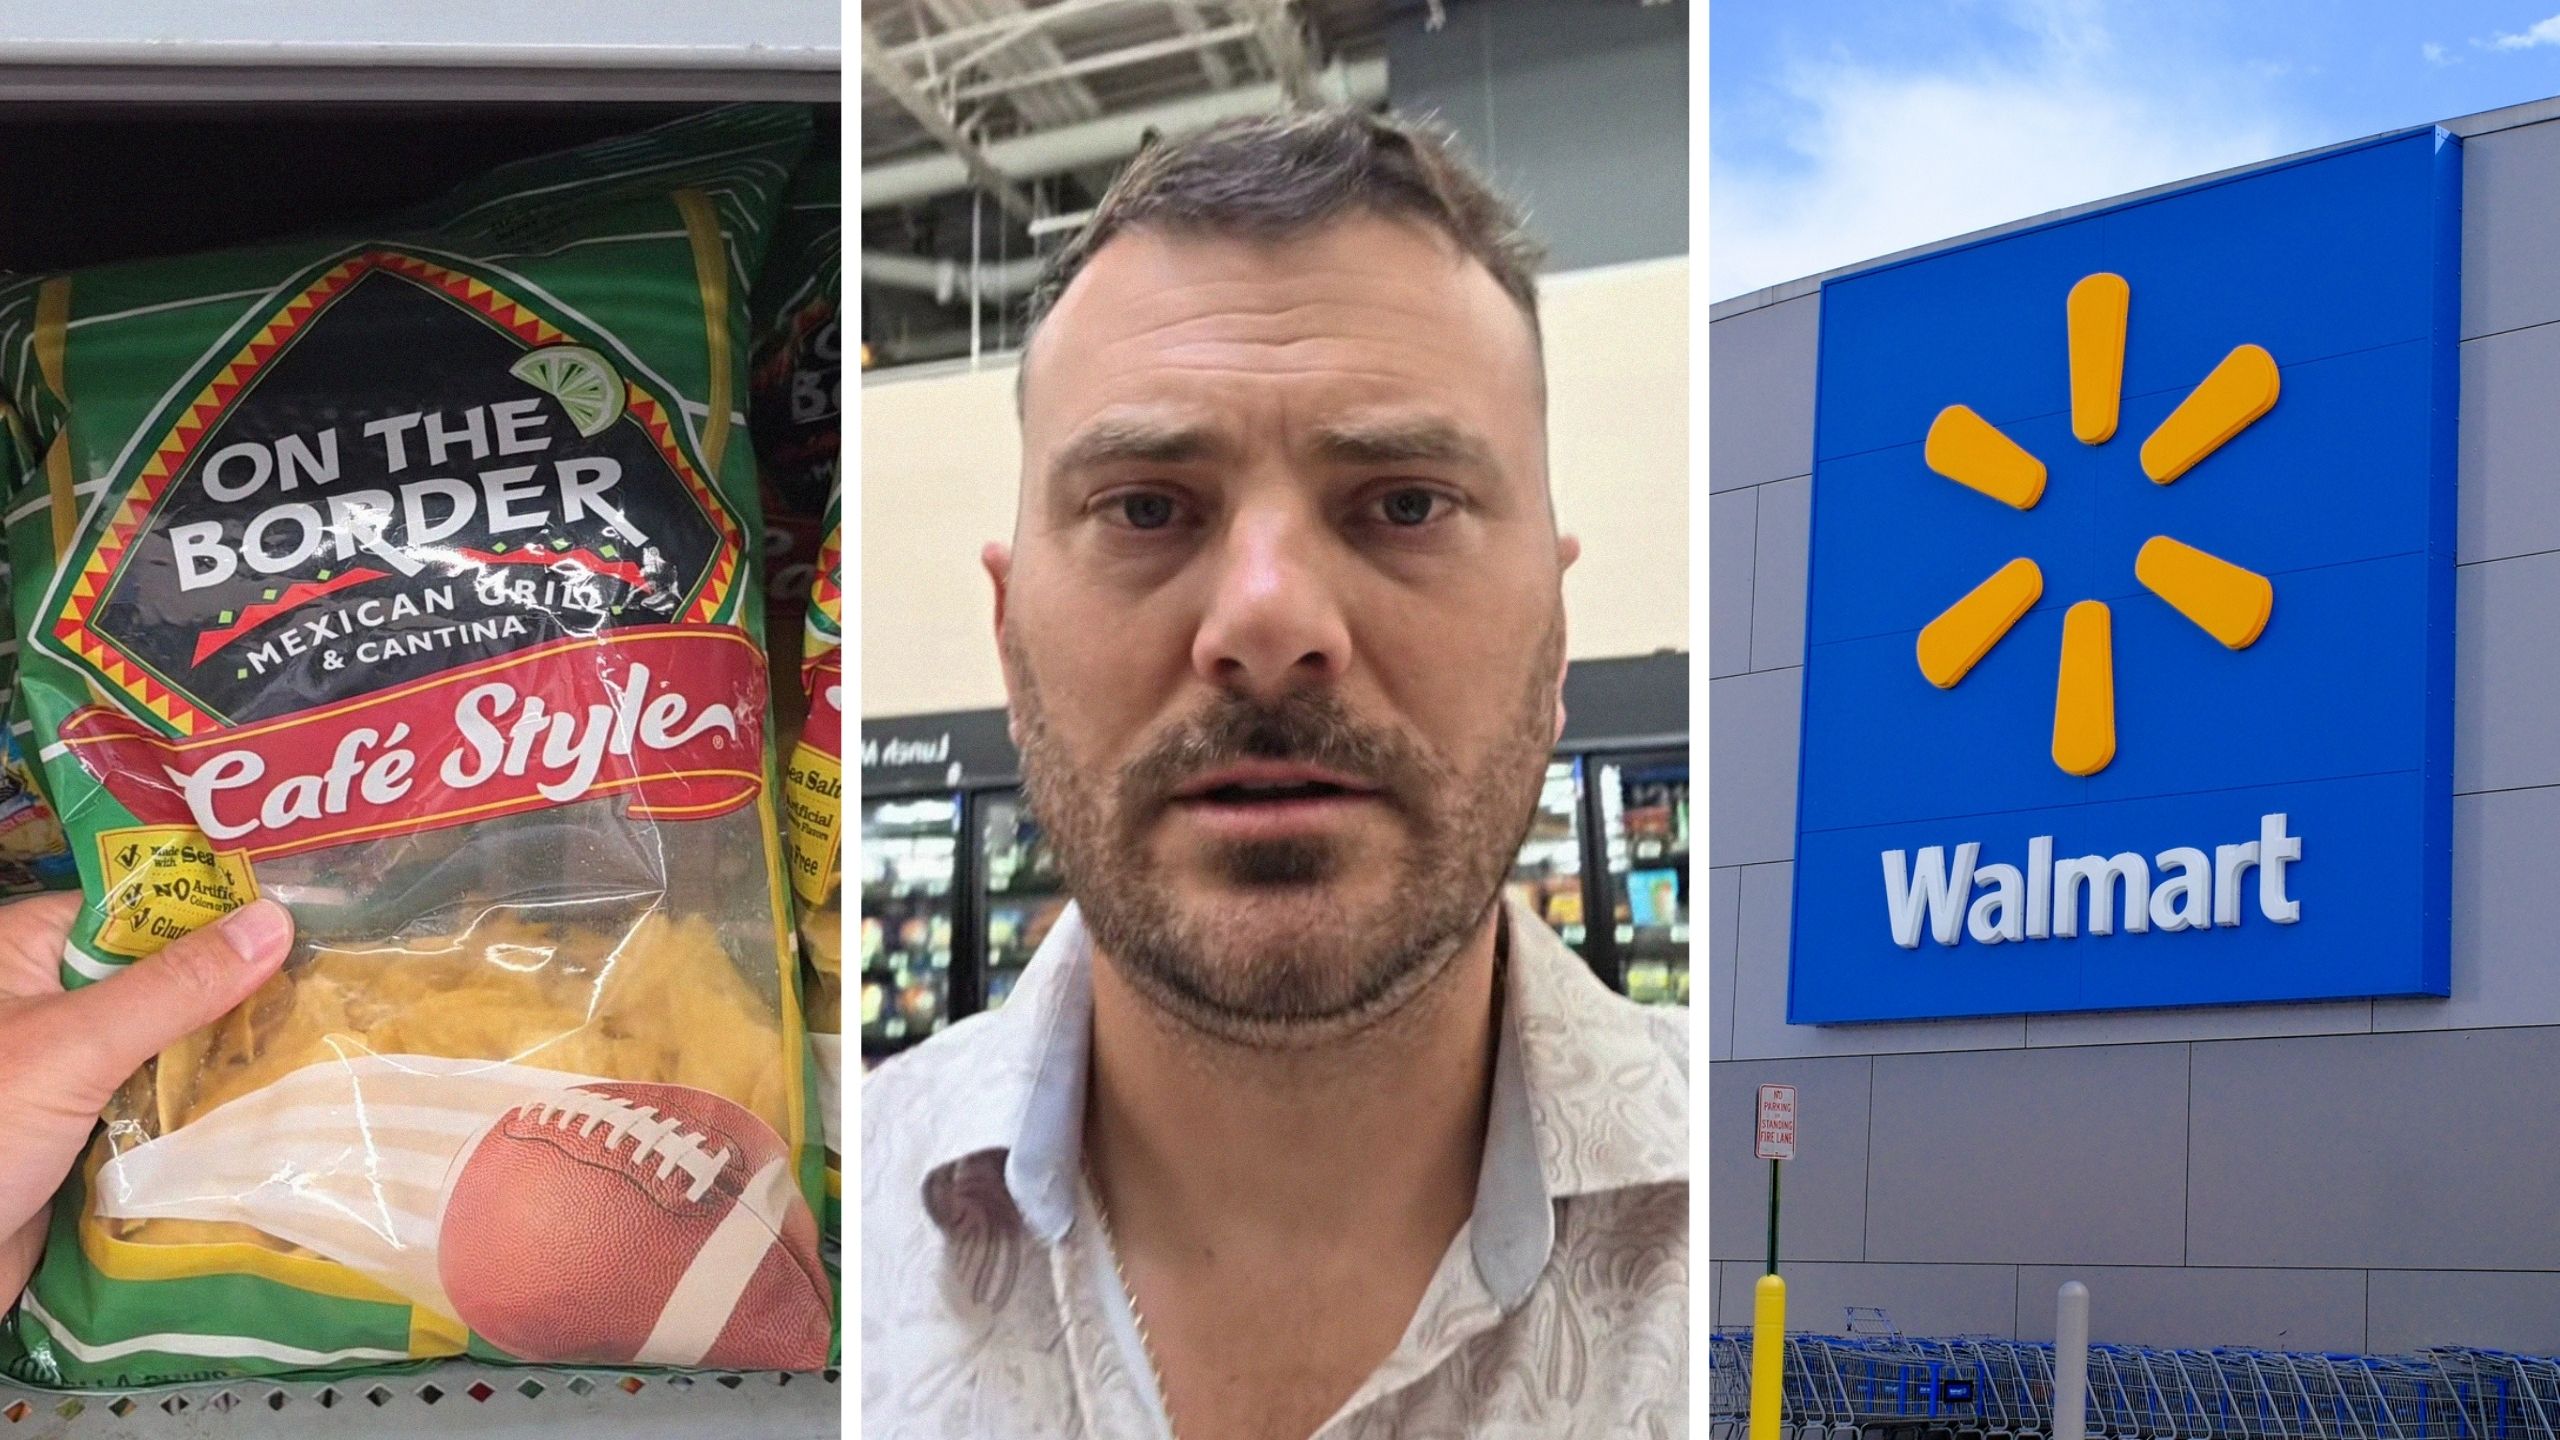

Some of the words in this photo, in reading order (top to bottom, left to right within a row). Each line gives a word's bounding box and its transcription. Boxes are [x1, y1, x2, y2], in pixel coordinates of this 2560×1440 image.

[202, 428, 339, 502] ON
[363, 398, 553, 474] THE
[169, 457, 649, 592] BORDER
[246, 585, 454, 675] MEXICAN
[322, 650, 346, 671] &
[356, 615, 527, 665] CANTINA
[162, 722, 417, 840] Café
[439, 662, 736, 802] Style
[787, 766, 804, 785] ea
[181, 846, 216, 868] Sea
[152, 878, 191, 901] NO
[1881, 813, 2301, 949] Walmart
[1762, 1120, 1793, 1131] STANDING
[1764, 1102, 1792, 1112] PARKING
[1760, 1131, 1775, 1143] FIRE
[1776, 1133, 1793, 1144] LANE
